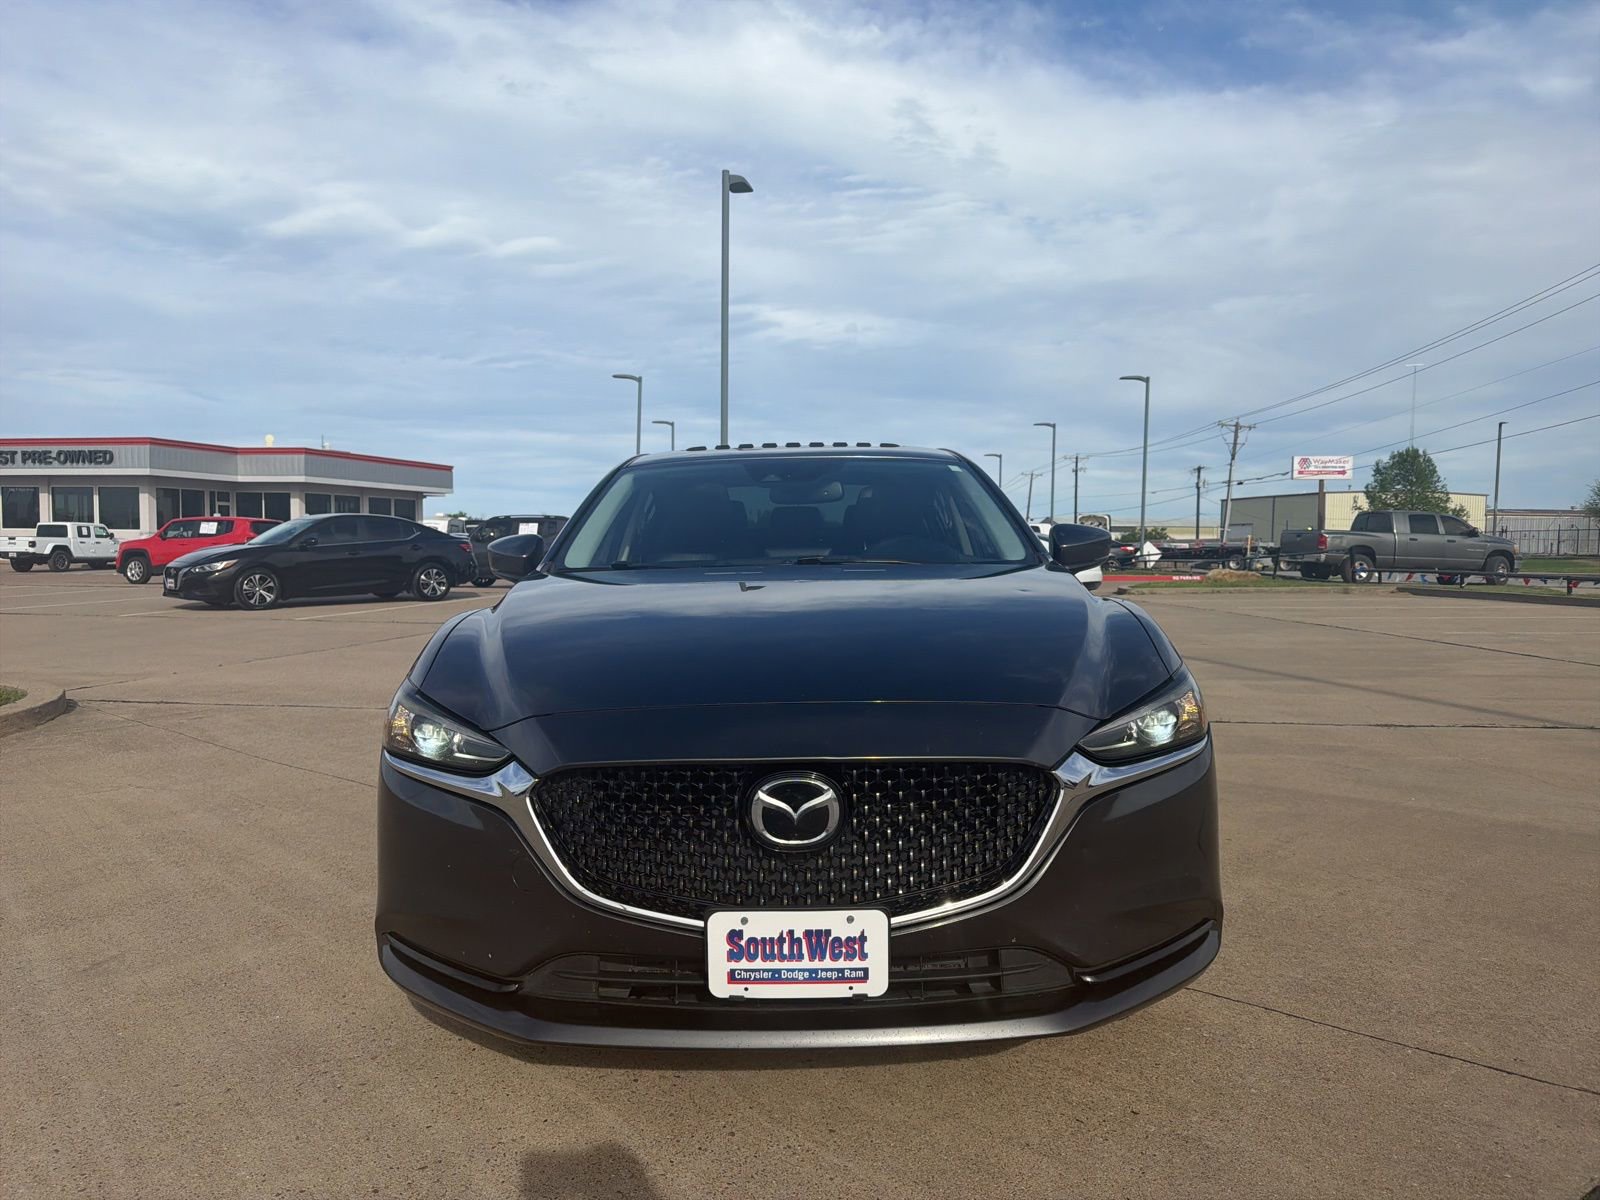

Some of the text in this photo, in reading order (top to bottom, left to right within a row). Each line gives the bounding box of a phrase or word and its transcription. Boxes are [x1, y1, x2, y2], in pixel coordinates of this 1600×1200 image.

[21, 450, 114, 465] PRE-OWNED
[735, 969, 864, 980] Chrysler Dodge Jeep Ram
